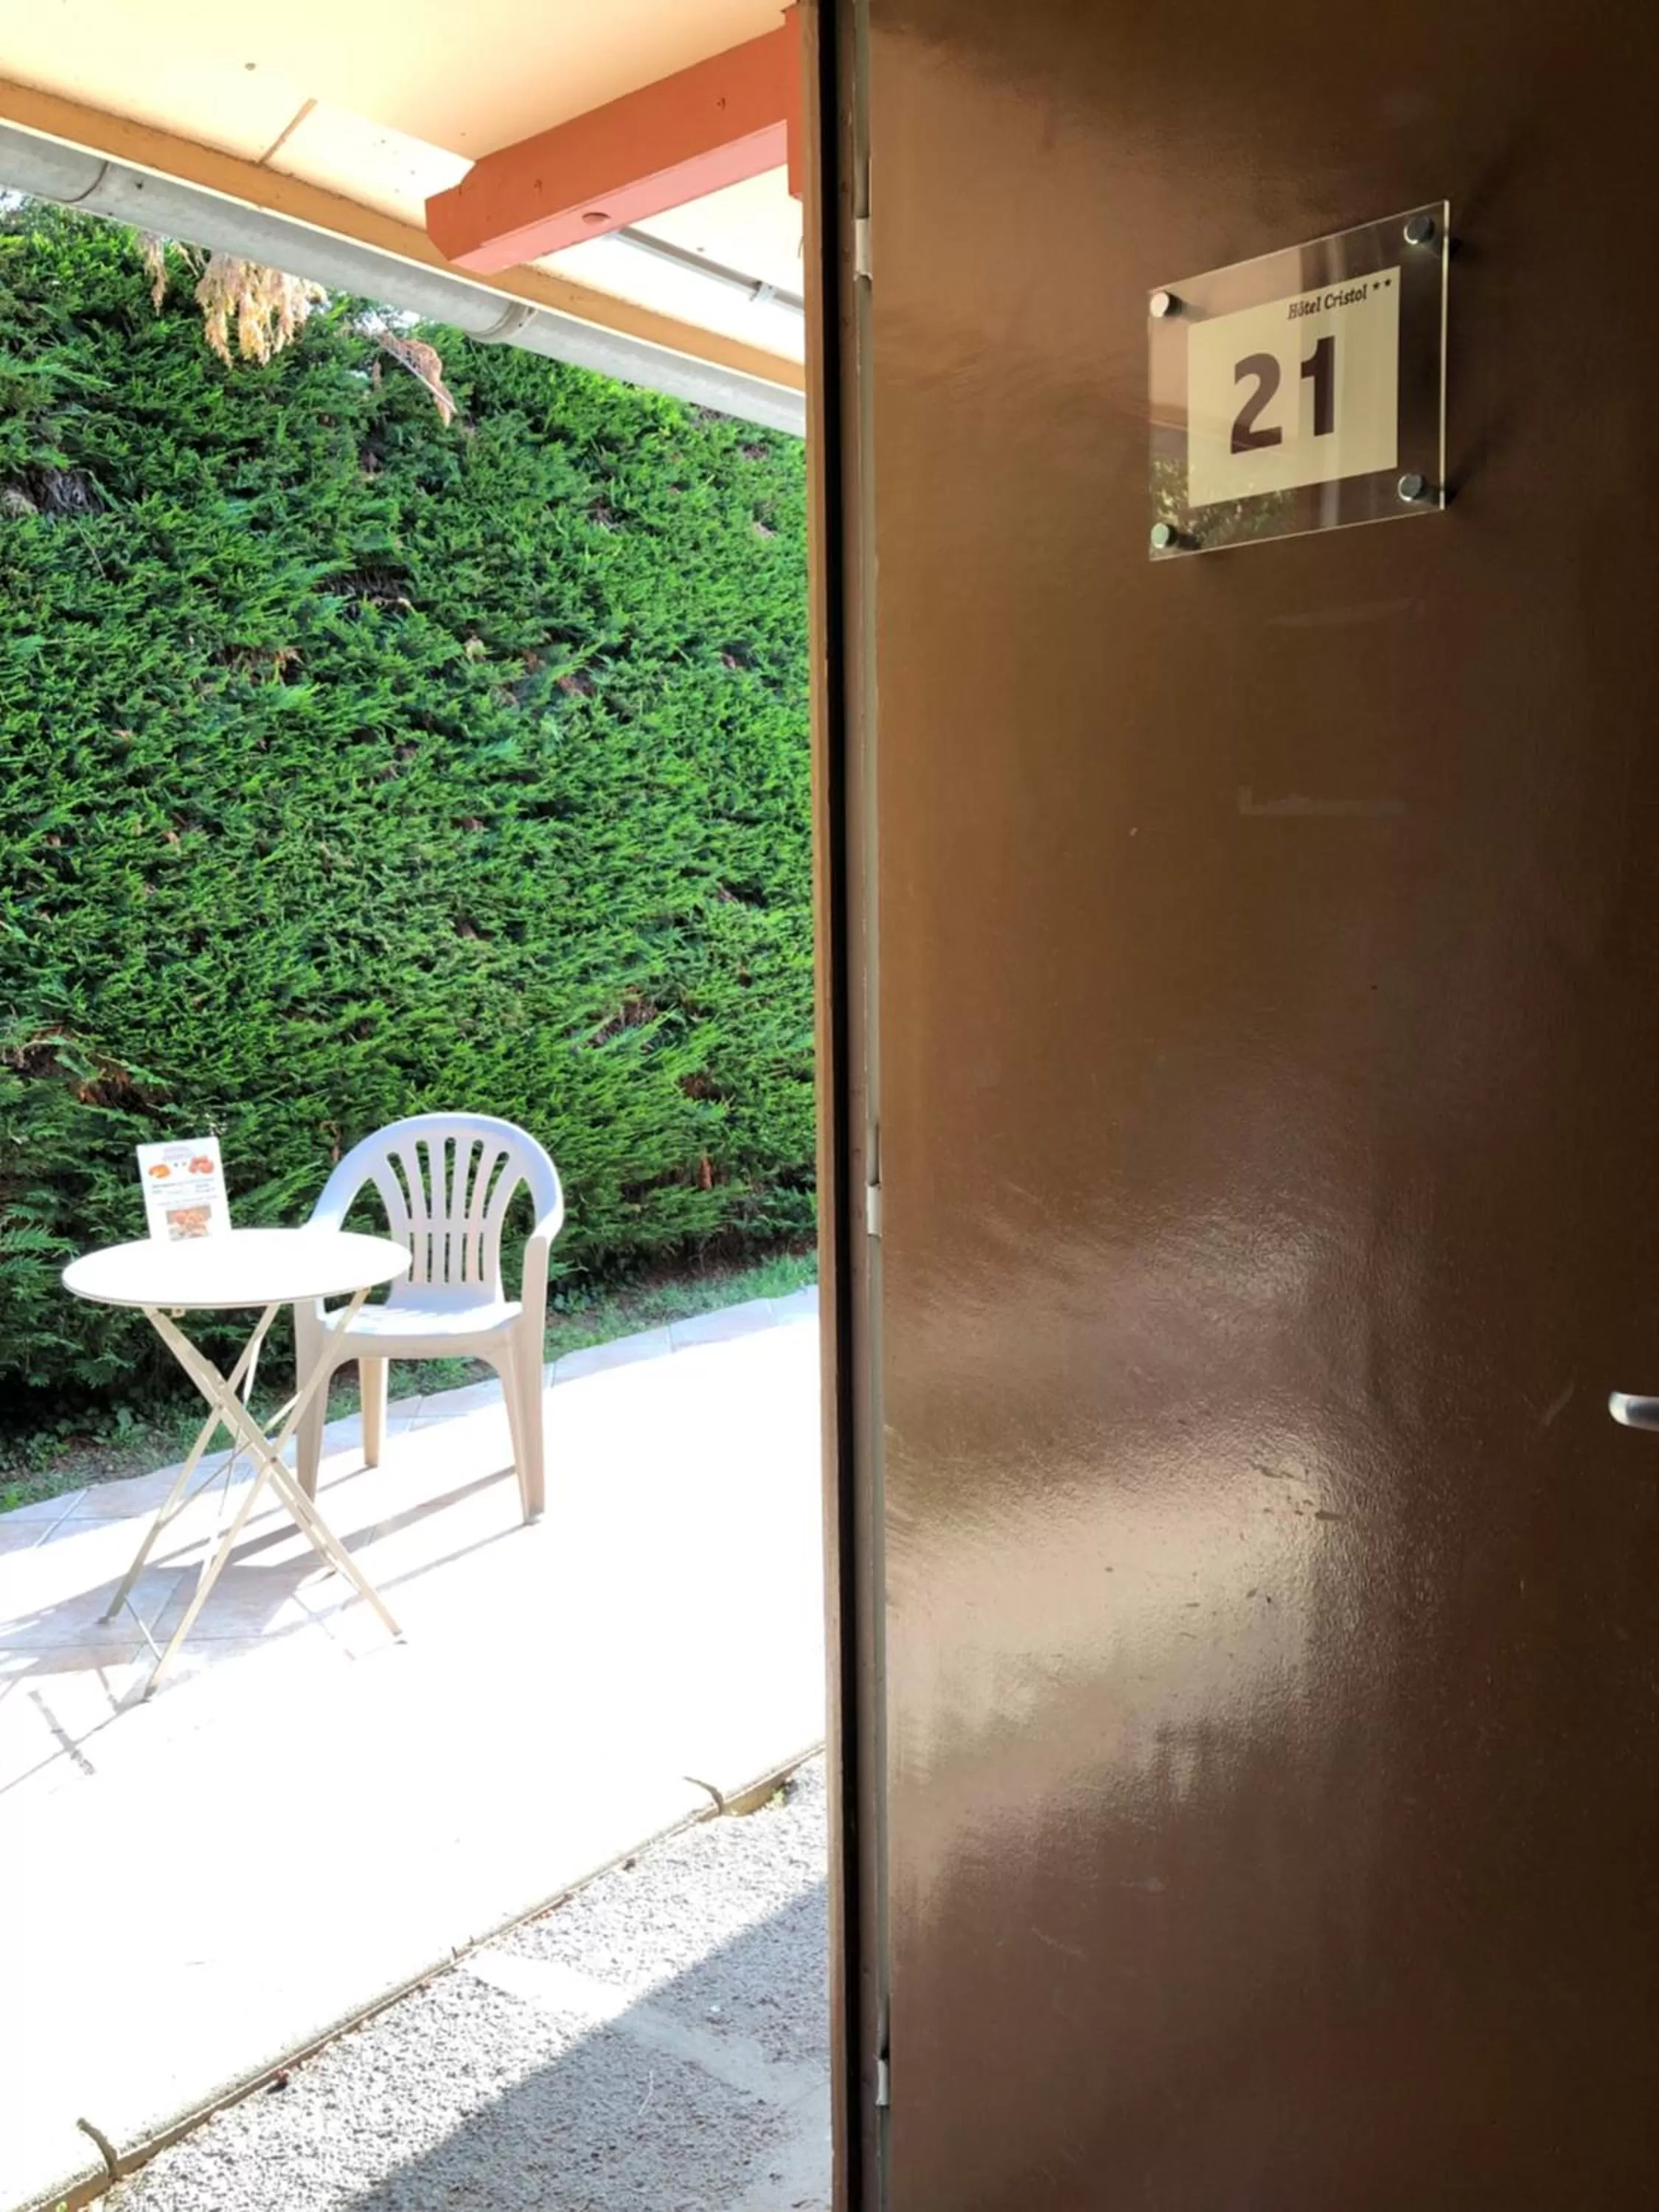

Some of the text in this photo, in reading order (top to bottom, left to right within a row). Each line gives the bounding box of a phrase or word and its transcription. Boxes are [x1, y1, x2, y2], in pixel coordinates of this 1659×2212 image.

[1288, 283, 1367, 319] Hôtel Cristol
[1231, 335, 1335, 454] 21
